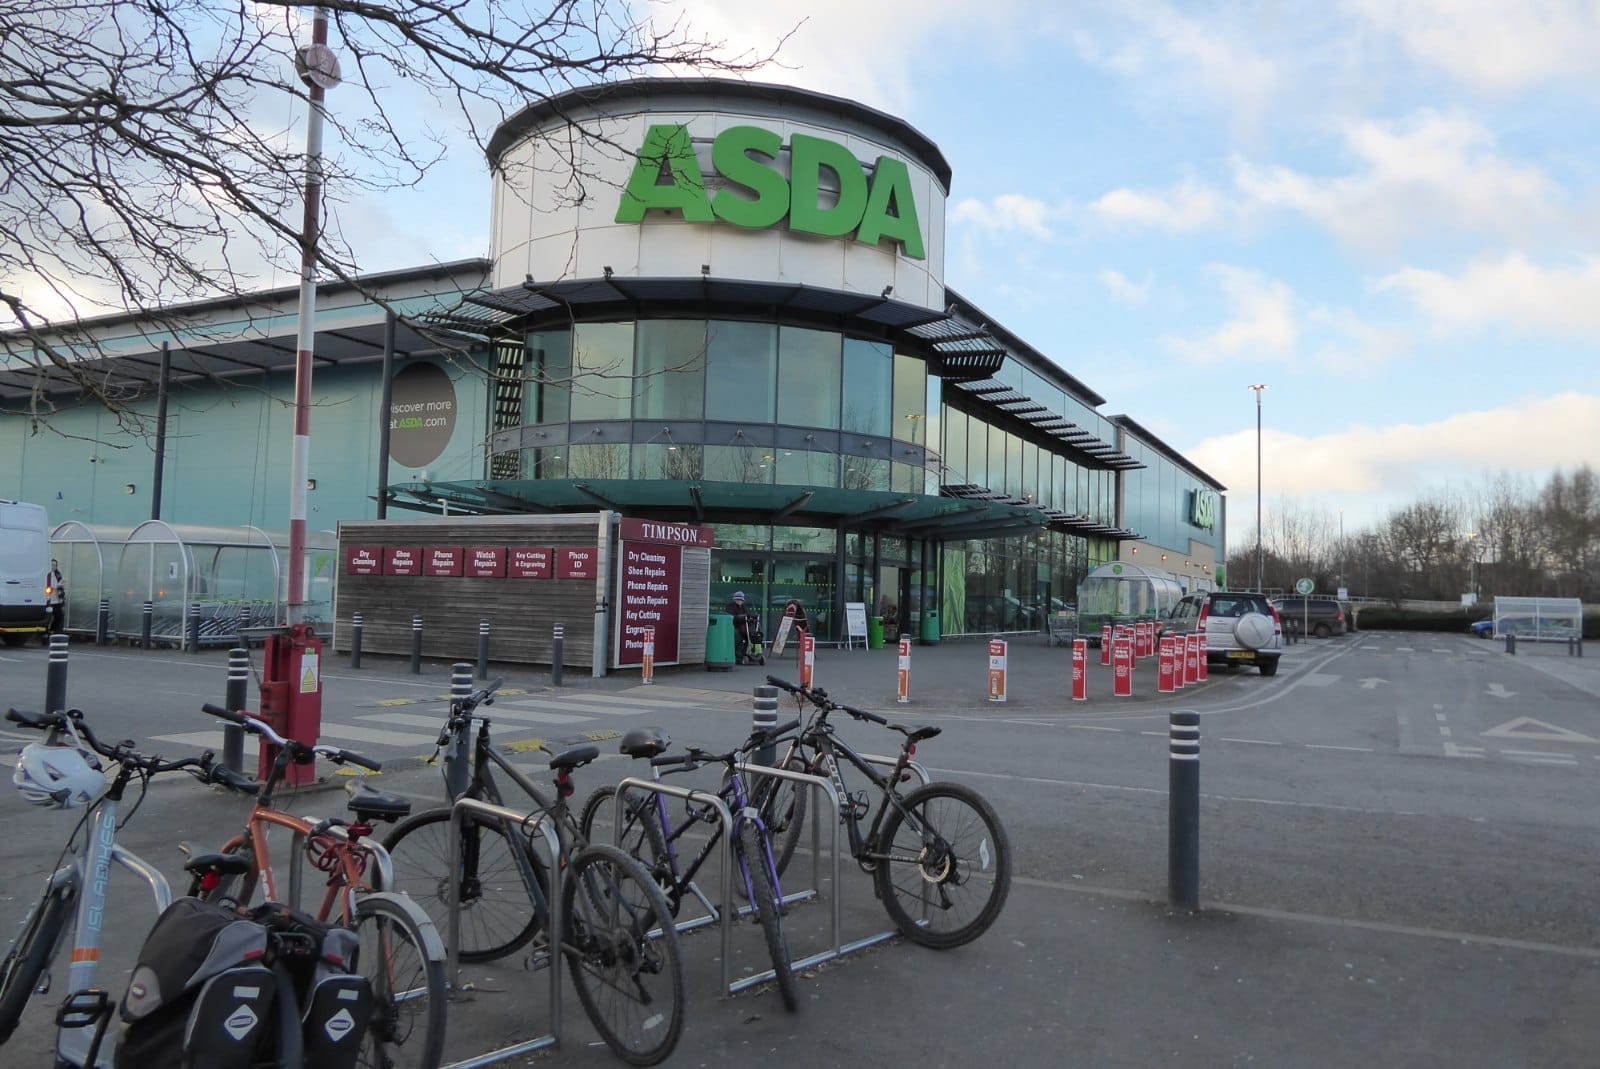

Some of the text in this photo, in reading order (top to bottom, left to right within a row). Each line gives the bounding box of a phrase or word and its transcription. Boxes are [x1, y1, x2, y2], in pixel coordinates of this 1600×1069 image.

[614, 123, 926, 261] ASDA
[426, 401, 452, 411] more
[1195, 489, 1214, 529] ASDA
[642, 523, 698, 543] TIMPSON
[359, 550, 370, 558] Dry
[395, 550, 411, 558] Shoe
[434, 550, 453, 558] Phone
[526, 552, 546, 560] Cutting
[568, 551, 589, 559] Photo
[628, 551, 666, 564] Dry Cleaning
[352, 558, 376, 567] Cleaning
[392, 558, 413, 567] Repairs
[432, 559, 454, 567] Repairs
[474, 559, 497, 568] Repairs
[628, 566, 666, 578] Shoe Repairs
[627, 581, 668, 592] Phone Repairs
[626, 595, 668, 606] Watch Repairs
[626, 610, 661, 621] Key Cutting
[625, 625, 645, 636] Engra
[625, 640, 643, 649] Photo
